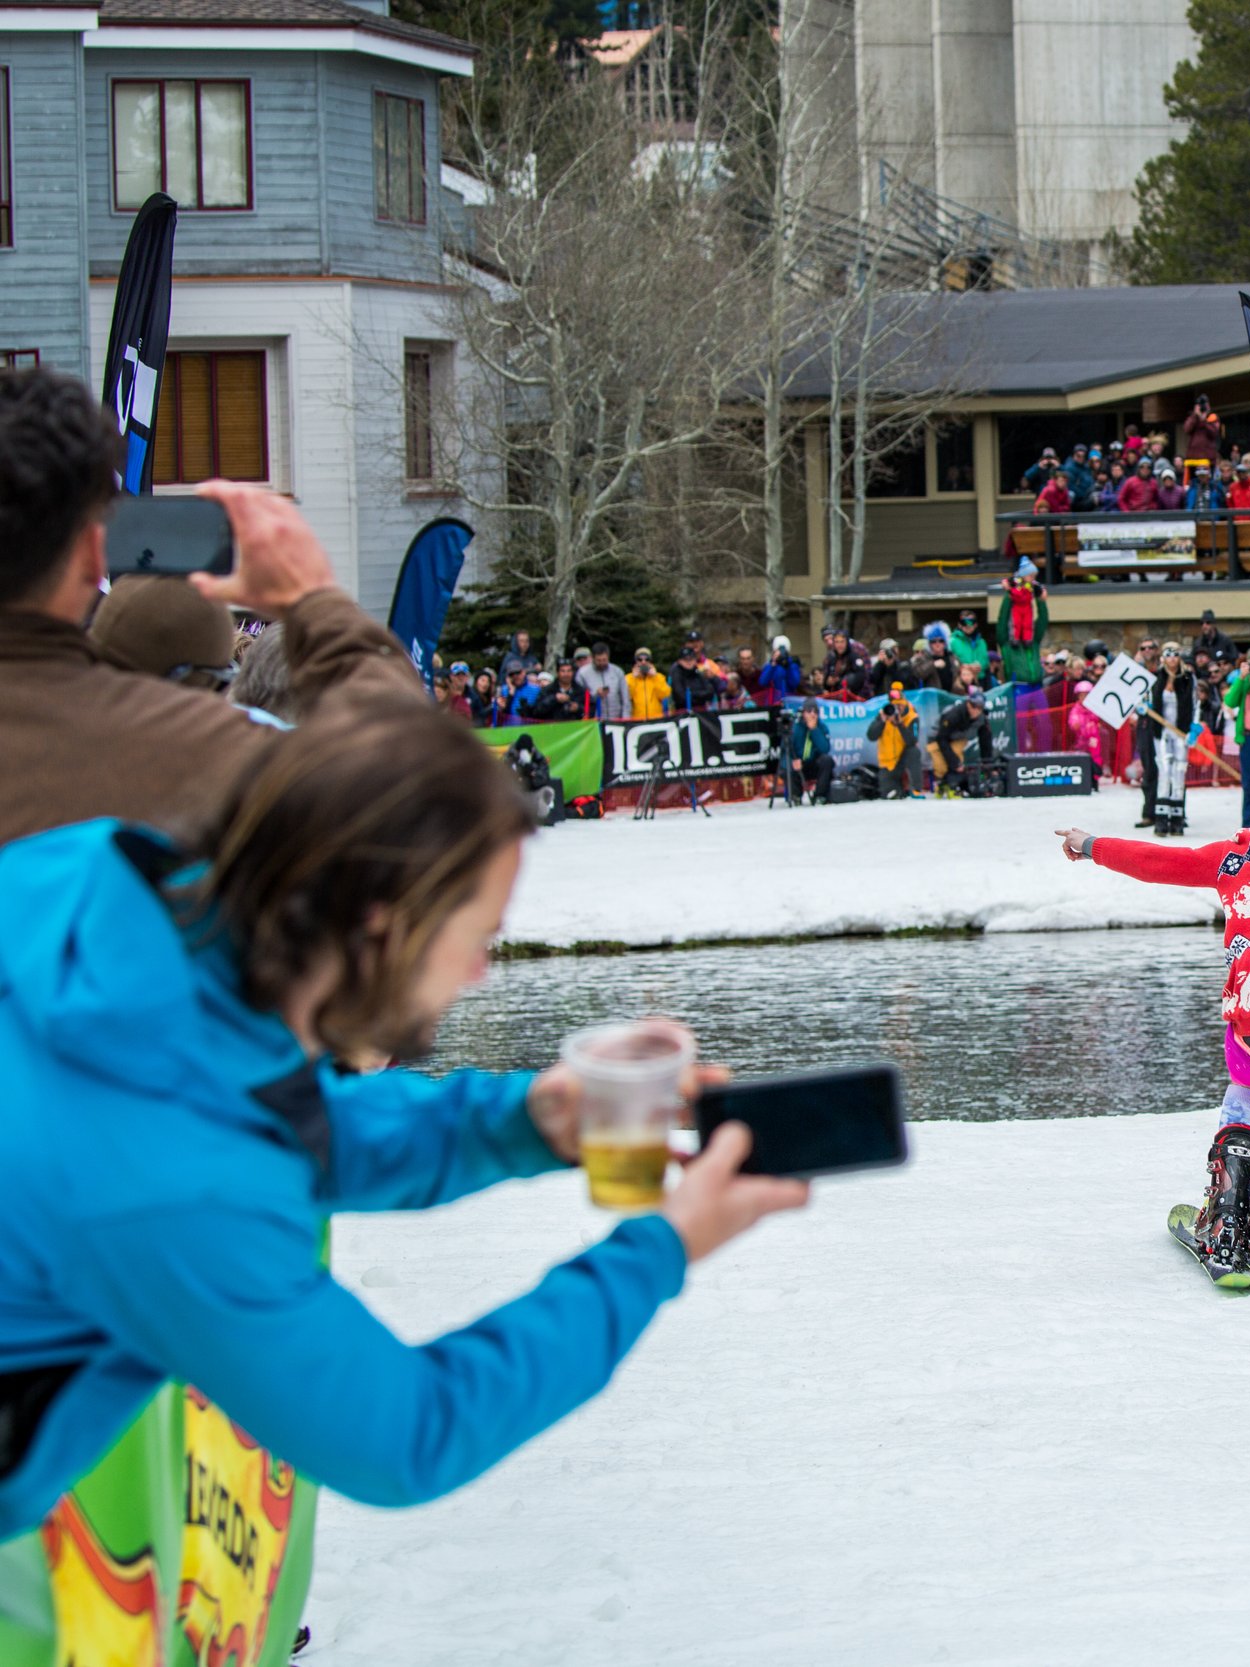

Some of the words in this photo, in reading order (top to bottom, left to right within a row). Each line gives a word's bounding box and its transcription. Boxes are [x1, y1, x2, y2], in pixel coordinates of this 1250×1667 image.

[1102, 667, 1149, 718] 25
[604, 710, 771, 775] 101.5
[830, 737, 864, 751] DER
[1016, 764, 1083, 779] GoPro
